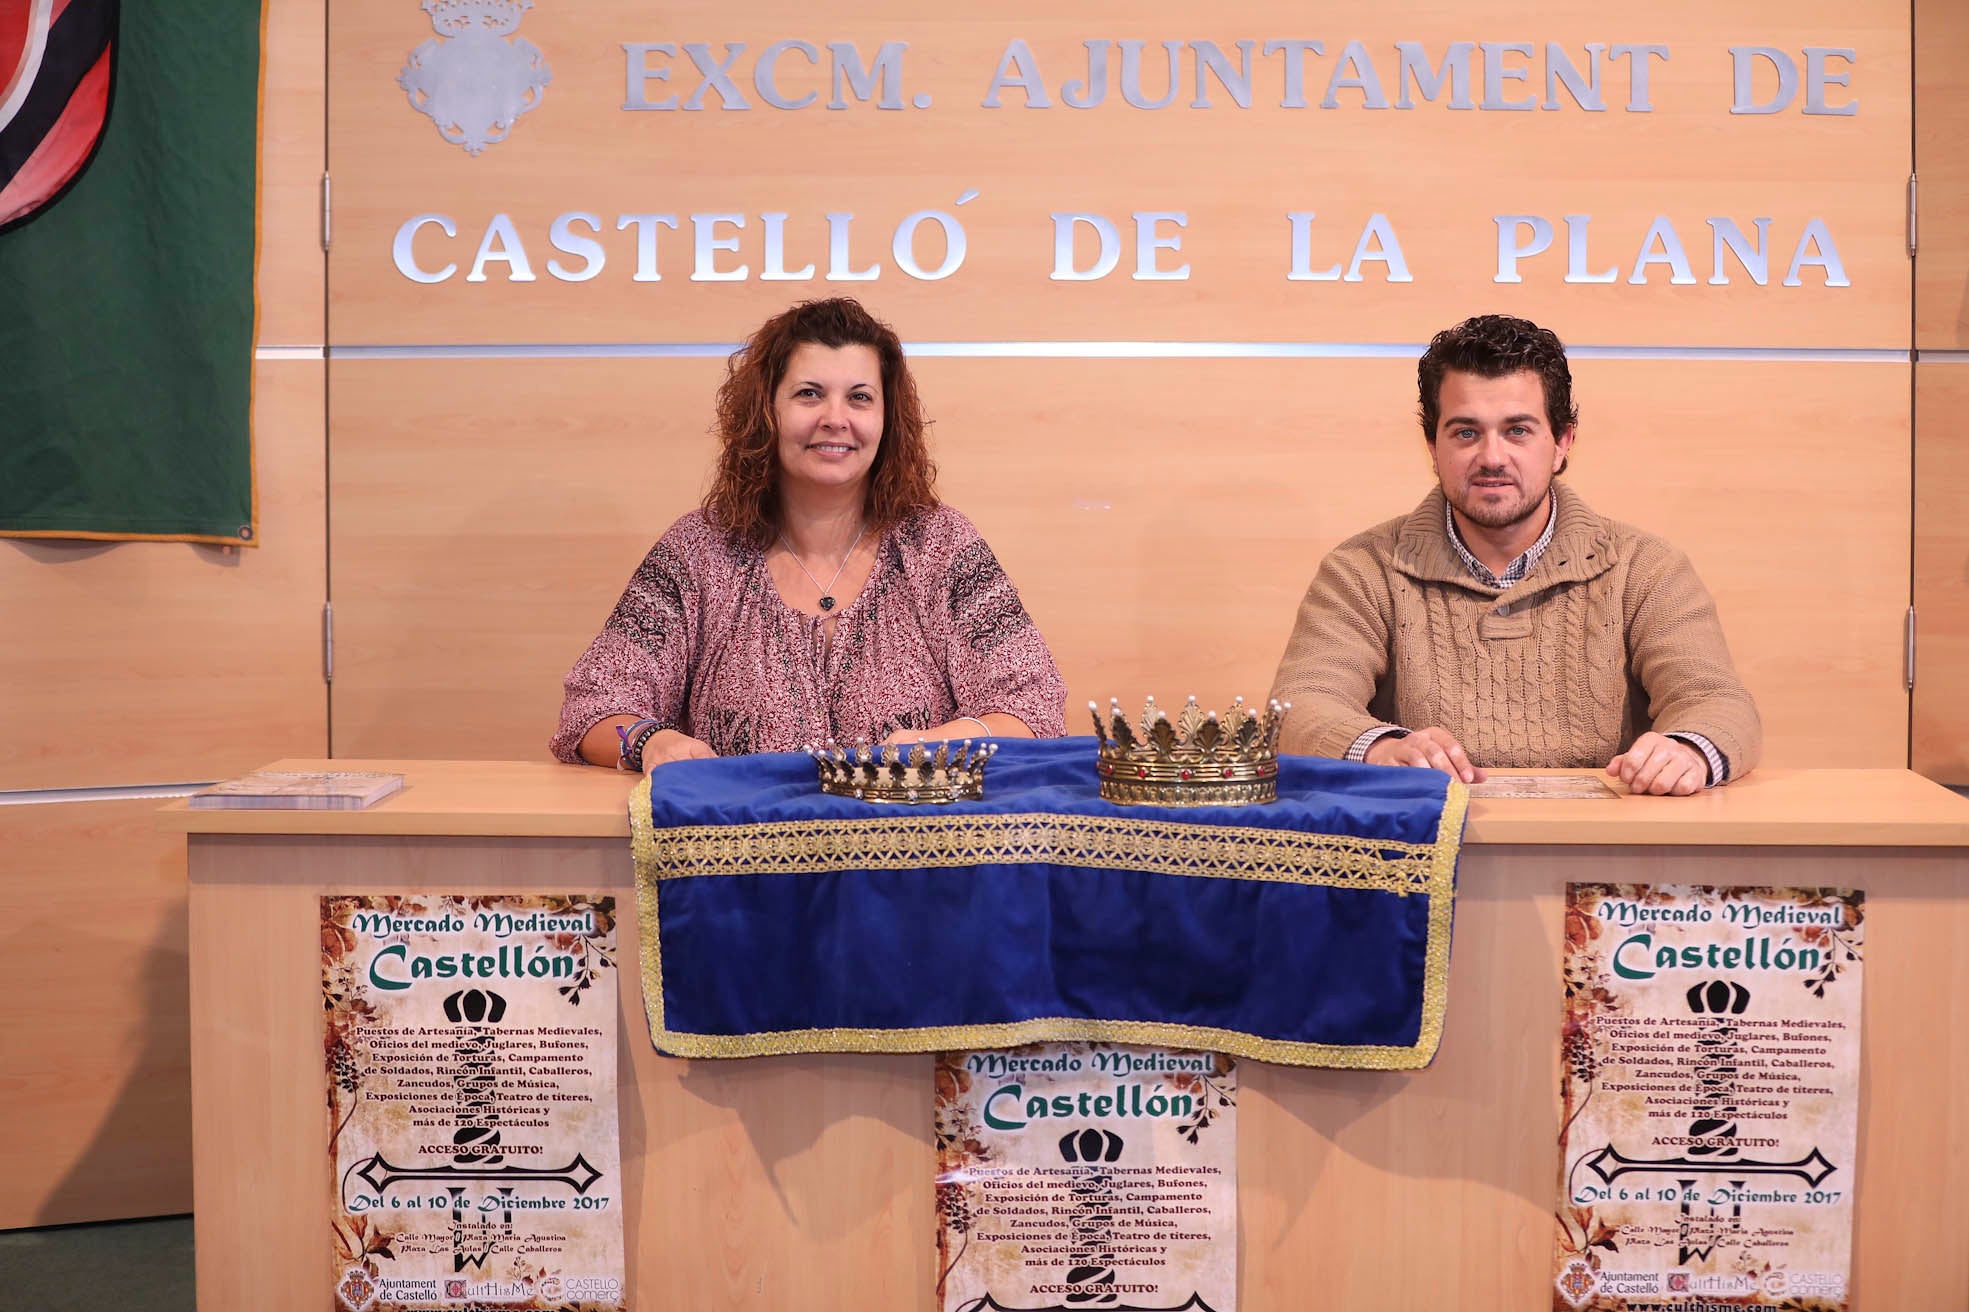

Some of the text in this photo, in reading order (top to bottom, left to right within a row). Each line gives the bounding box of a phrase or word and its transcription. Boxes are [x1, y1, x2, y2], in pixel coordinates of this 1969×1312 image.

[621, 39, 1859, 116] EXCM. AJUNTAMENT DE
[392, 188, 1850, 287] CASTELLÓ DE LA PLANA
[1598, 902, 1841, 929] Mercado Medieval
[352, 912, 592, 938] Mercado Medieval
[1613, 934, 1820, 979] Castellón
[369, 945, 574, 990] Castellón
[1596, 1016, 1640, 1025] Puestos
[1643, 1017, 1657, 1025] de
[1727, 1018, 1778, 1028] Tabernas
[1781, 1019, 1846, 1030] Medievales,
[356, 1027, 399, 1035] Puestos
[402, 1027, 415, 1035] de
[483, 1027, 534, 1035] Tabernas
[538, 1027, 602, 1036] Medievales,
[1610, 1030, 1832, 1042] Oficios del medievo, Juglares, Bufones,
[370, 1040, 589, 1050] Oficios del medievo, Juglares, Bufones,
[1612, 1043, 1826, 1055] Exposición de Torturas, Campamento
[372, 1053, 584, 1063] Exposición de Torturas, Campamento
[967, 1052, 1213, 1078] Mercado Medieval
[365, 1066, 592, 1076] de Soldados, Rincón Infantil, Caballeros,
[397, 1079, 560, 1090] Zancudos, Grupos de Música,
[366, 1092, 438, 1102] Exposiciones
[441, 1092, 454, 1101] de
[496, 1092, 533, 1101] Teatro
[536, 1092, 549, 1101] de
[409, 1105, 480, 1114] Asociaciones
[483, 1105, 540, 1114] Históricas
[983, 1084, 1192, 1130] Castellón
[1648, 1110, 1671, 1118] más
[1674, 1110, 1687, 1118] de
[1714, 1110, 1788, 1120] Espectáculos
[413, 1118, 549, 1128] más de 120 Espectáculos
[1651, 1136, 1780, 1147] ACCESO GRATUITO!
[418, 1145, 543, 1154] ACCESO GRATUITO!
[969, 1167, 1013, 1176] Puestos
[1016, 1167, 1030, 1176] de
[1100, 1166, 1152, 1175] Tabernas
[1155, 1165, 1221, 1175] Medievales,
[983, 1179, 1207, 1190] Oficios del medievo, Juglares, Bufones,
[985, 1192, 1202, 1203] Exposición de Torturas, Campamento
[1574, 1186, 1842, 1205] Del 6 al 10 de Diciembre 2017
[348, 1194, 609, 1212] Del 6 al 10 de Diciembre 2017
[976, 1205, 1211, 1216] de Soldados, Rincón Infantil, Caballeros,
[1010, 1218, 1178, 1229] Zancudos, Grupos de Música,
[977, 1232, 1052, 1242] Exposiciones
[1055, 1232, 1068, 1240] de
[1112, 1231, 1150, 1240] Teatro
[1153, 1231, 1167, 1240] de
[1021, 1245, 1095, 1253] Asociaciones
[1098, 1244, 1157, 1253] Históricas
[1025, 1257, 1048, 1266] más
[1051, 1257, 1064, 1266] de
[1091, 1257, 1166, 1267] Espectáculos
[1600, 1272, 1659, 1283] Ajuntament
[379, 1279, 436, 1290] Ajuntament
[1030, 1284, 1158, 1293] ACCESO GRATUITO!
[1600, 1283, 1613, 1293] de
[380, 1290, 392, 1300] de
